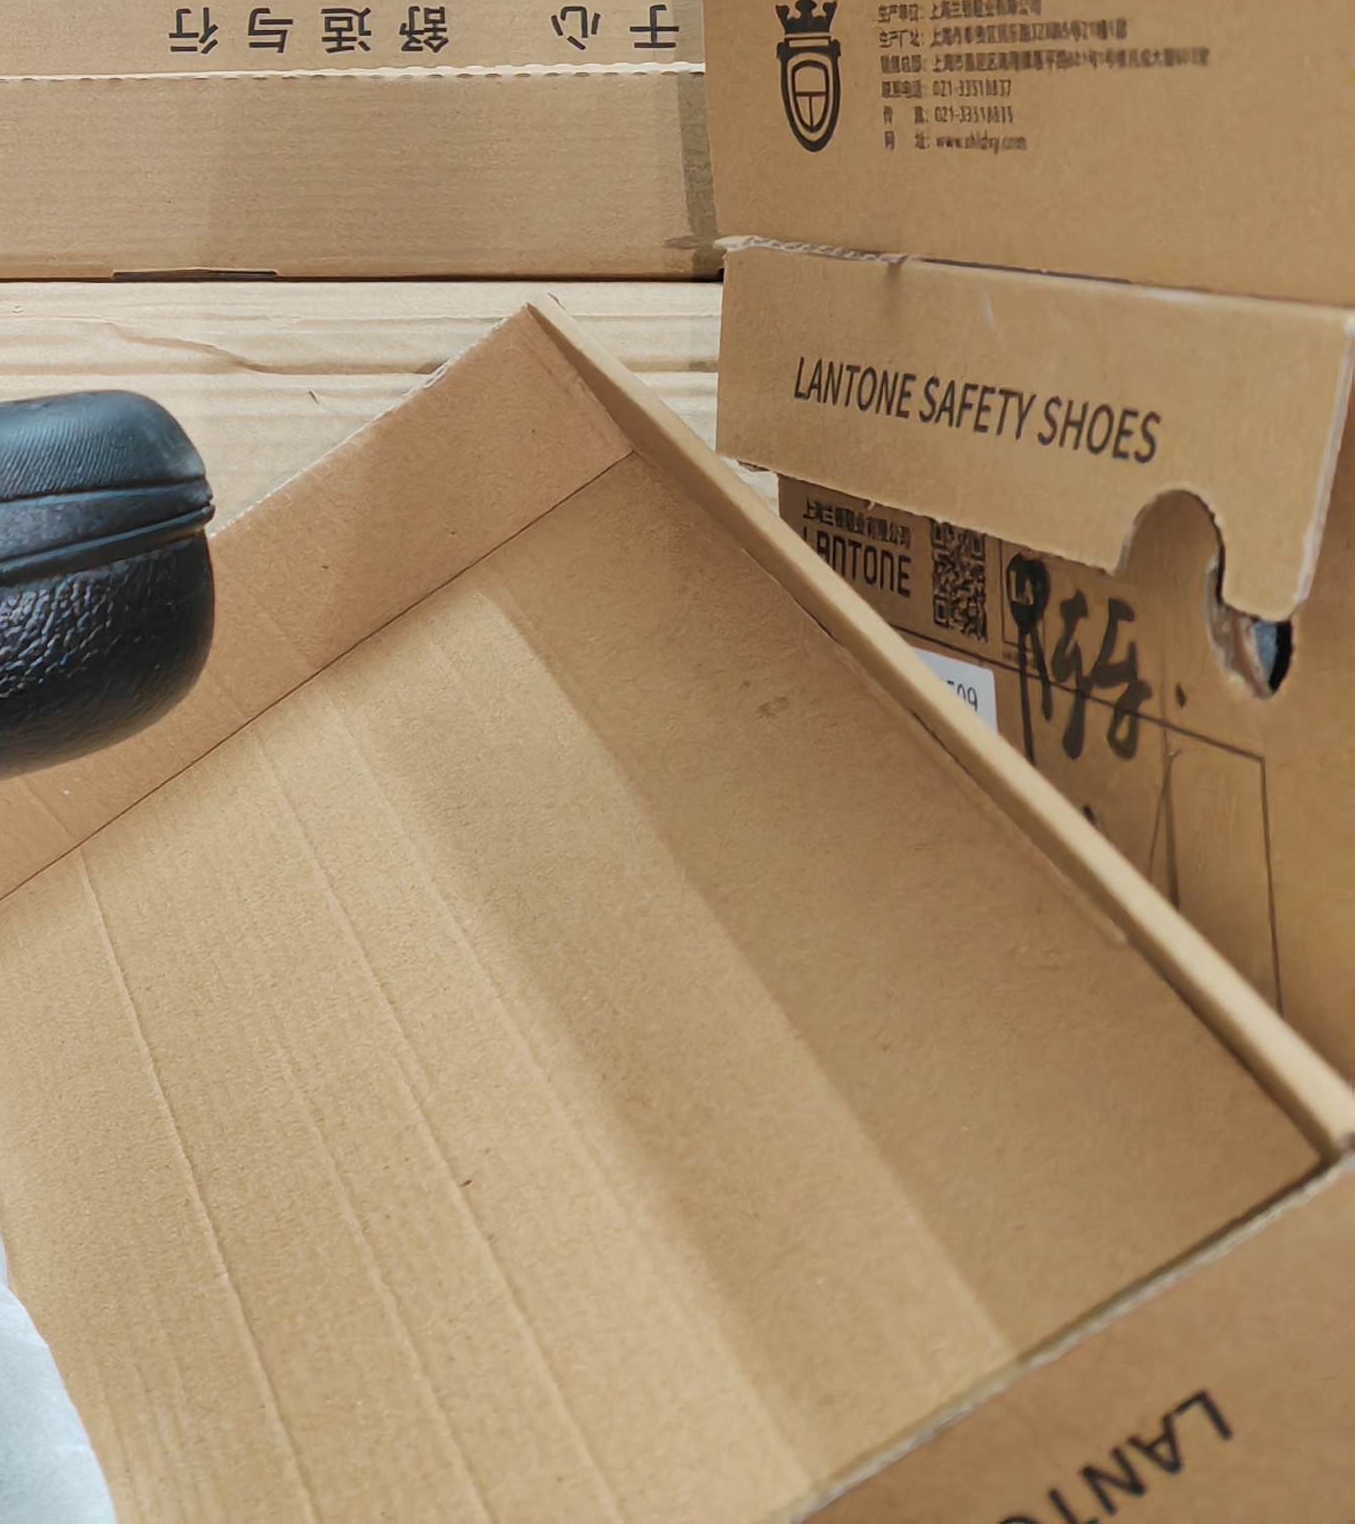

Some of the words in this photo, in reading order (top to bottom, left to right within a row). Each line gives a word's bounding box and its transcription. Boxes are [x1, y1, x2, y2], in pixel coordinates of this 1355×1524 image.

[169, 6, 449, 55] 舒适与行
[551, 4, 680, 51] 于心
[793, 356, 917, 420] LANTONE
[919, 376, 1036, 442] SAFETY
[1037, 395, 1162, 464] SHOES
[1000, 1390, 1233, 1524] LANT
